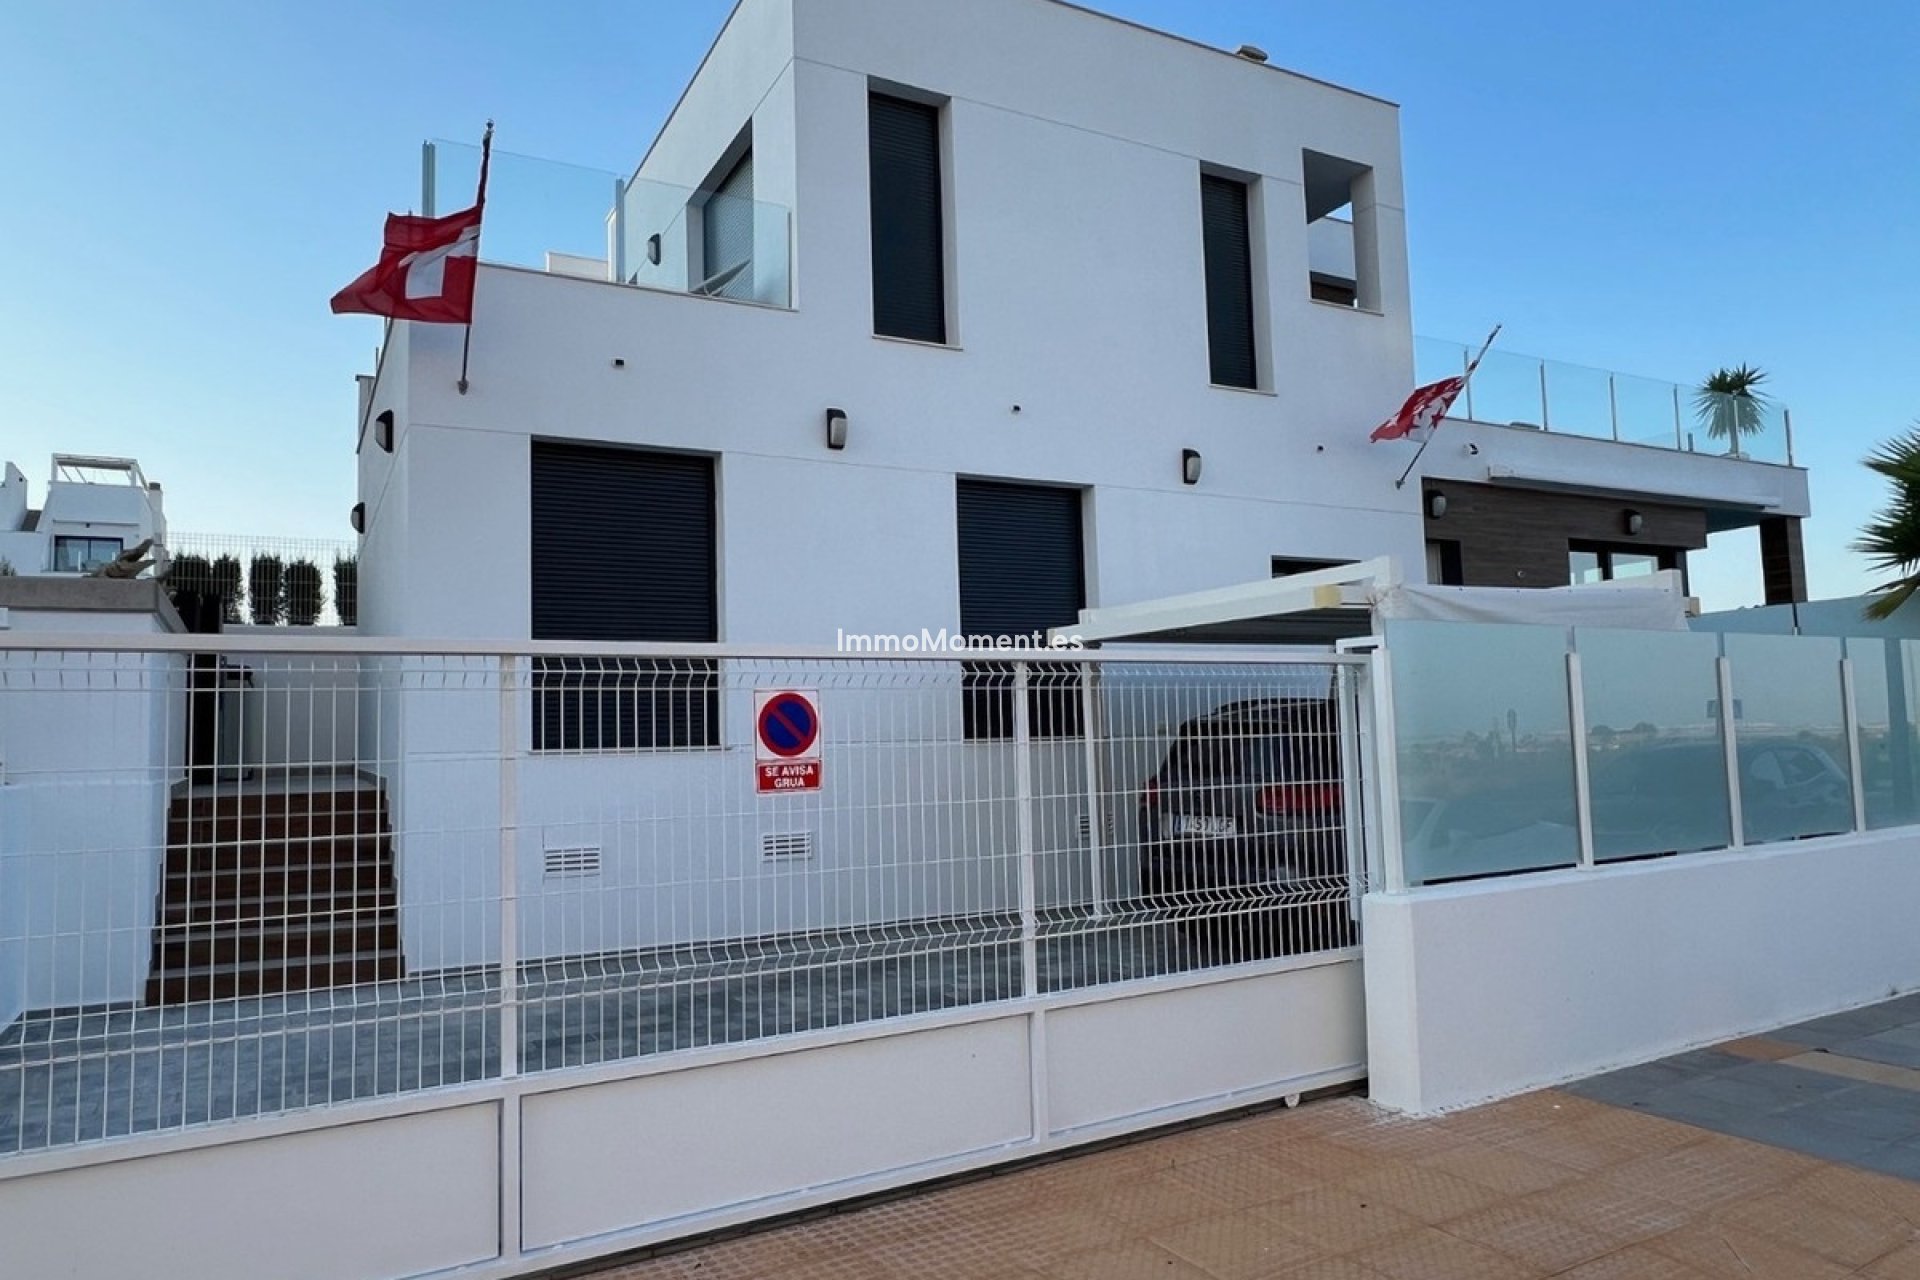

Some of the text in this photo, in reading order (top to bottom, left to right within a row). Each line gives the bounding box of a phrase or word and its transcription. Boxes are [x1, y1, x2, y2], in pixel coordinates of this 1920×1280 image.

[765, 765, 813, 777] SE AVISA
[774, 777, 805, 788] GRUA
